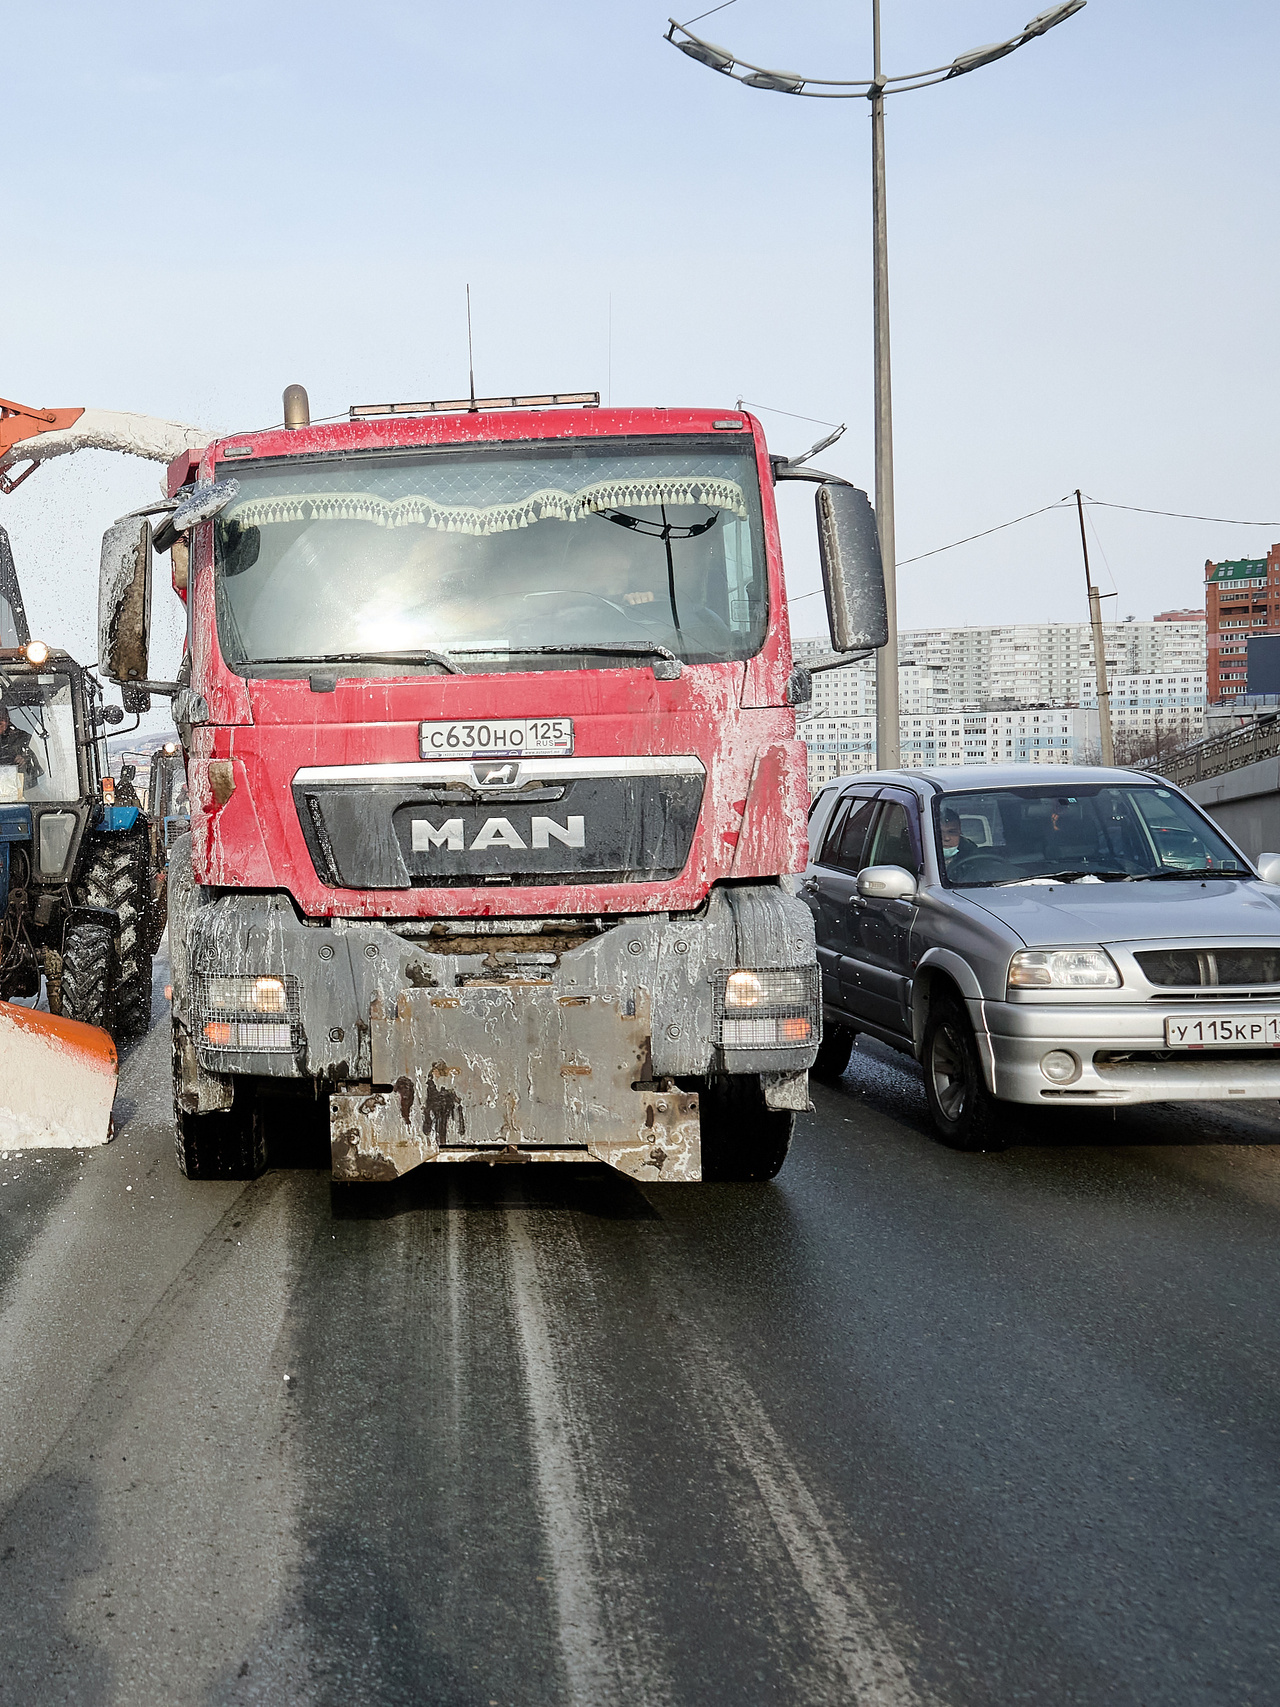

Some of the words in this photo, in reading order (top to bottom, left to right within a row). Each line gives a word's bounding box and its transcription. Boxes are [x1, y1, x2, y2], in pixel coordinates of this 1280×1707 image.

[430, 724, 524, 748] С630НО
[528, 722, 564, 740] 125
[411, 815, 586, 851] MAN
[1176, 1020, 1263, 1041] У115КР
[1268, 1018, 1280, 1033] 1
